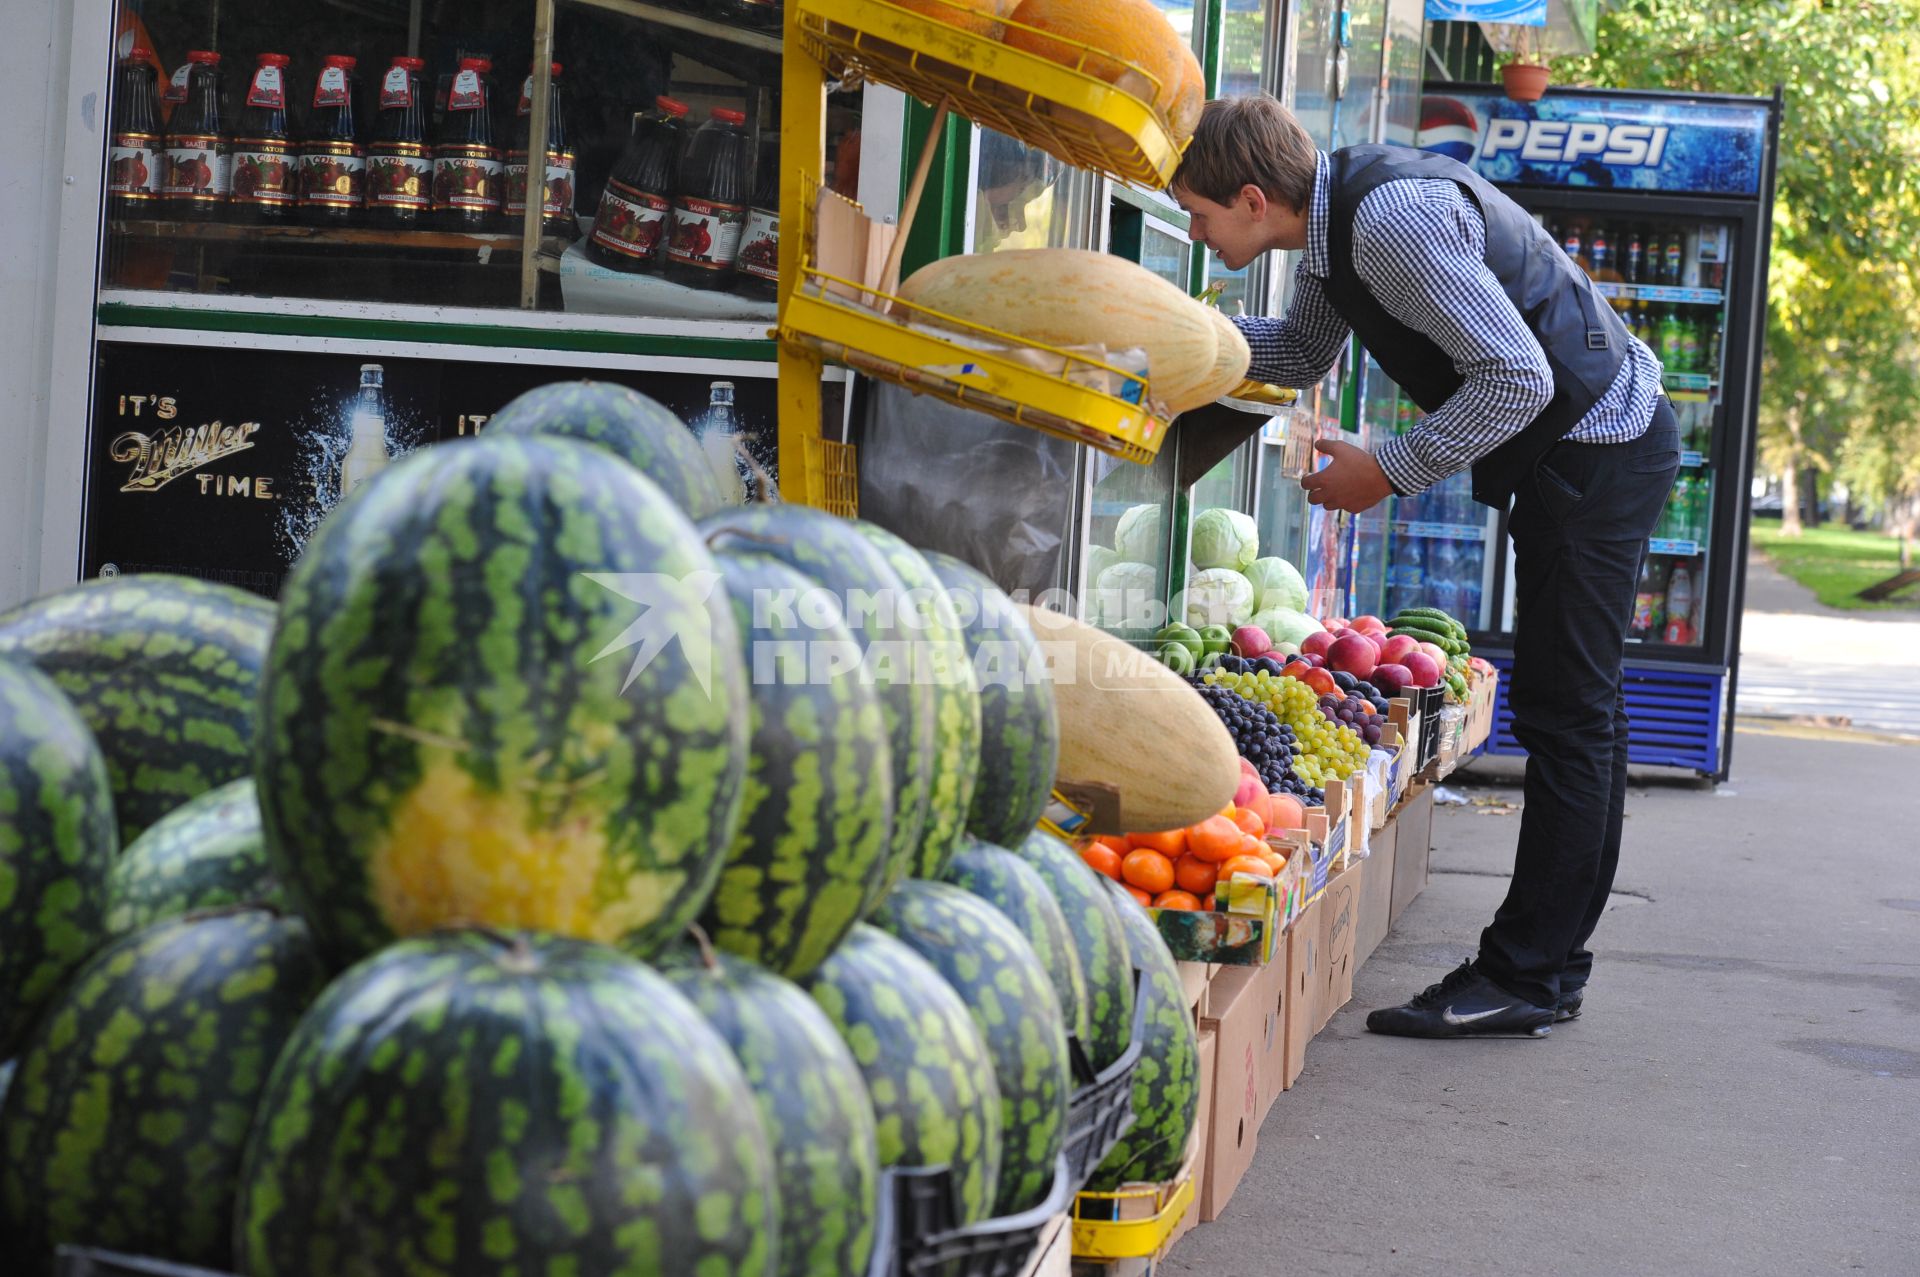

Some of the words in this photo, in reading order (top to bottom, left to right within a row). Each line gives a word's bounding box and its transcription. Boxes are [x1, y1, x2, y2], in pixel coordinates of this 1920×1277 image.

[1481, 118, 1669, 167] PEPSI
[119, 394, 178, 419] IT'S
[111, 420, 260, 487] Miller
[195, 473, 282, 499] TIME.
